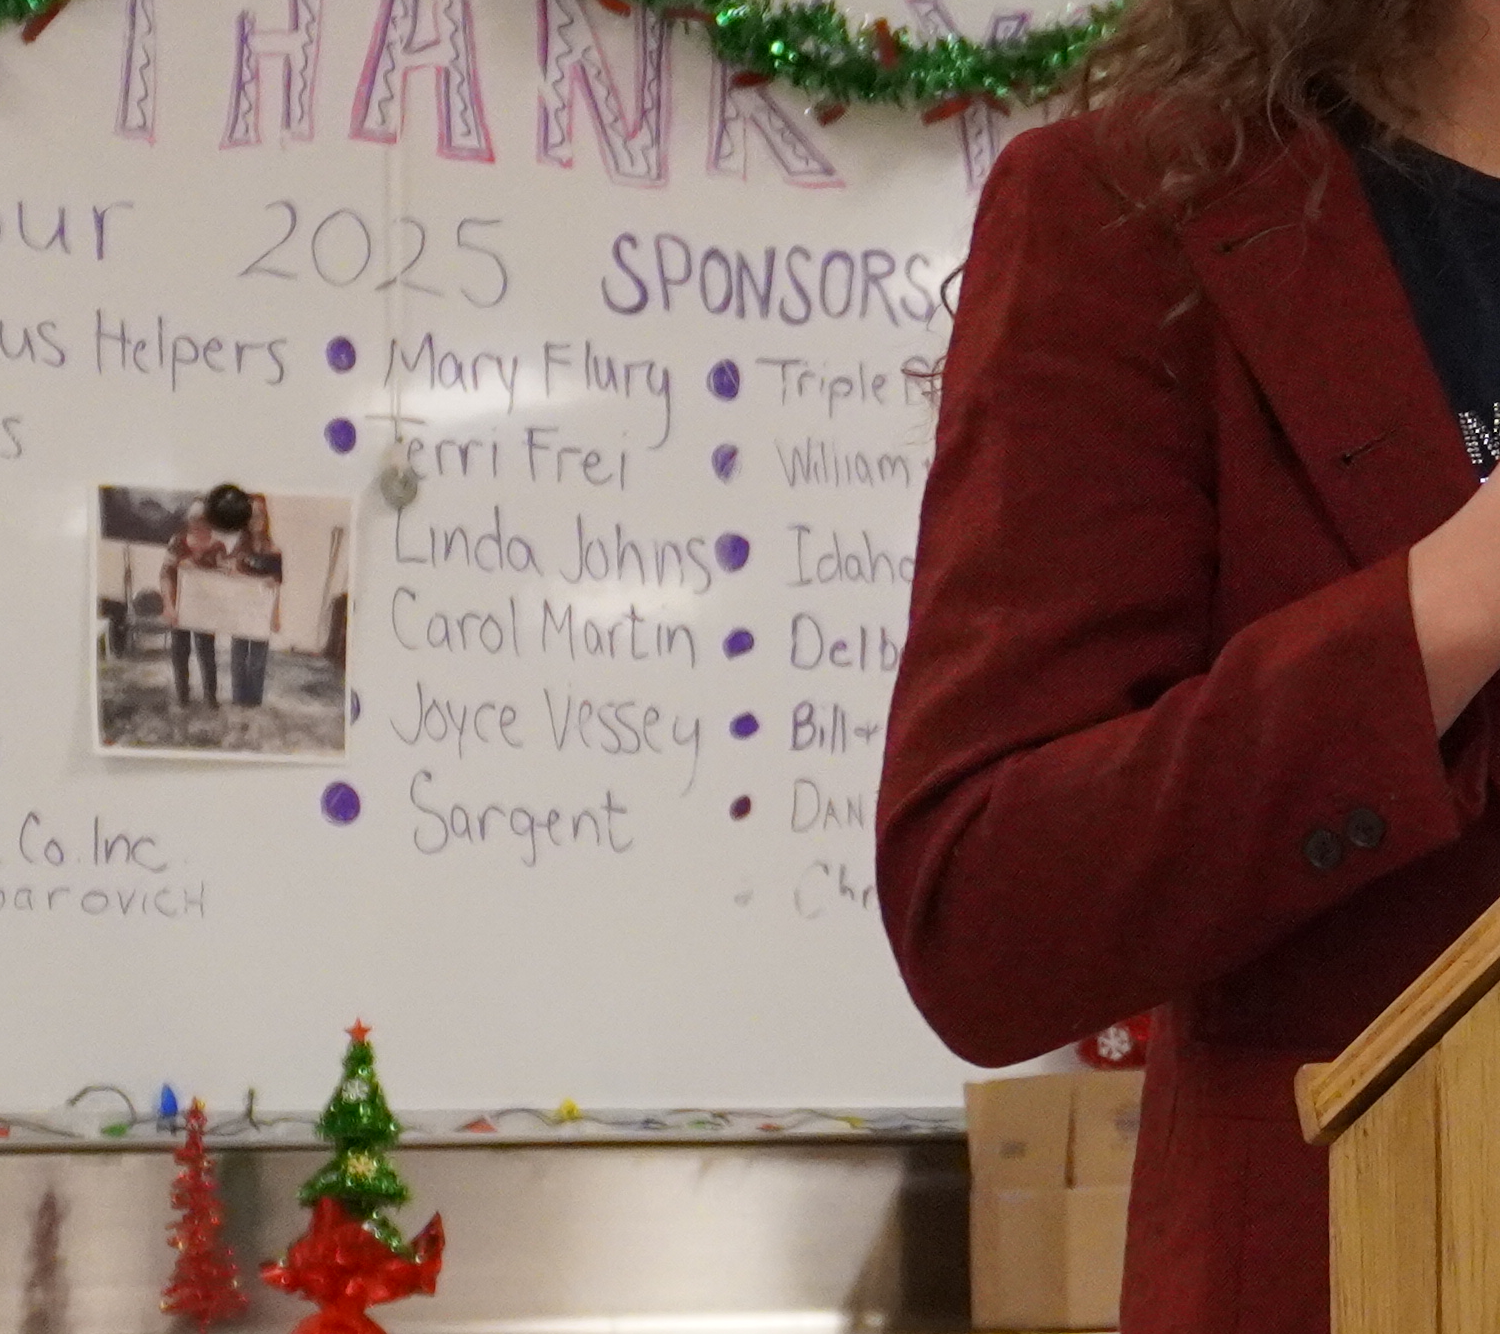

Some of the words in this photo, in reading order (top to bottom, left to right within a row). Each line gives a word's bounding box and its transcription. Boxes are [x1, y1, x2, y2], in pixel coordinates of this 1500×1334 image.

[240, 200, 509, 308] 2025
[602, 232, 936, 327] SPONSORS
[95, 308, 288, 392] Helpers
[384, 331, 518, 415] Mary
[542, 339, 672, 451] Flury
[755, 356, 887, 419] Triple
[524, 425, 626, 492] Frei
[394, 504, 545, 577] Linda
[391, 586, 520, 656] Carol
[540, 598, 697, 668] Martin
[788, 611, 905, 673] Delb
[390, 679, 520, 757] Joyce
[542, 687, 702, 797] Vessey
[409, 768, 635, 868] Sargent
